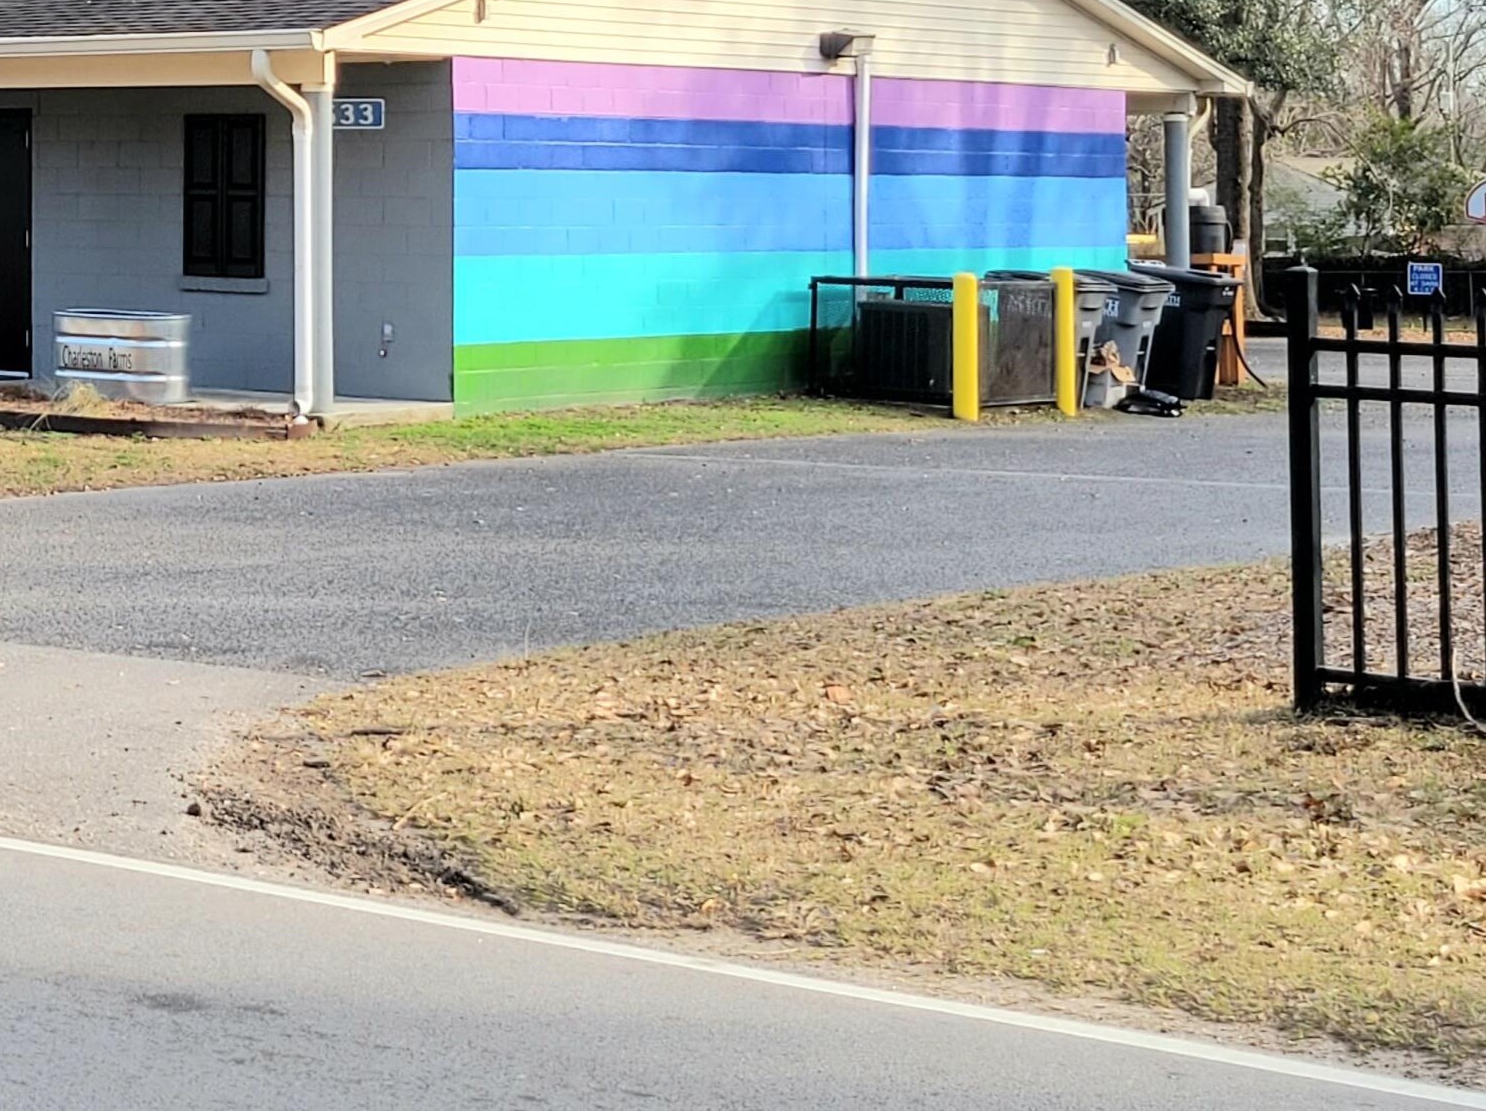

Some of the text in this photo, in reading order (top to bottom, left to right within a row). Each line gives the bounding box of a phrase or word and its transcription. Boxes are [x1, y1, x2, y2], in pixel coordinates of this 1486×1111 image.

[332, 103, 374, 125] 33
[63, 345, 132, 369] Charleston Farms
